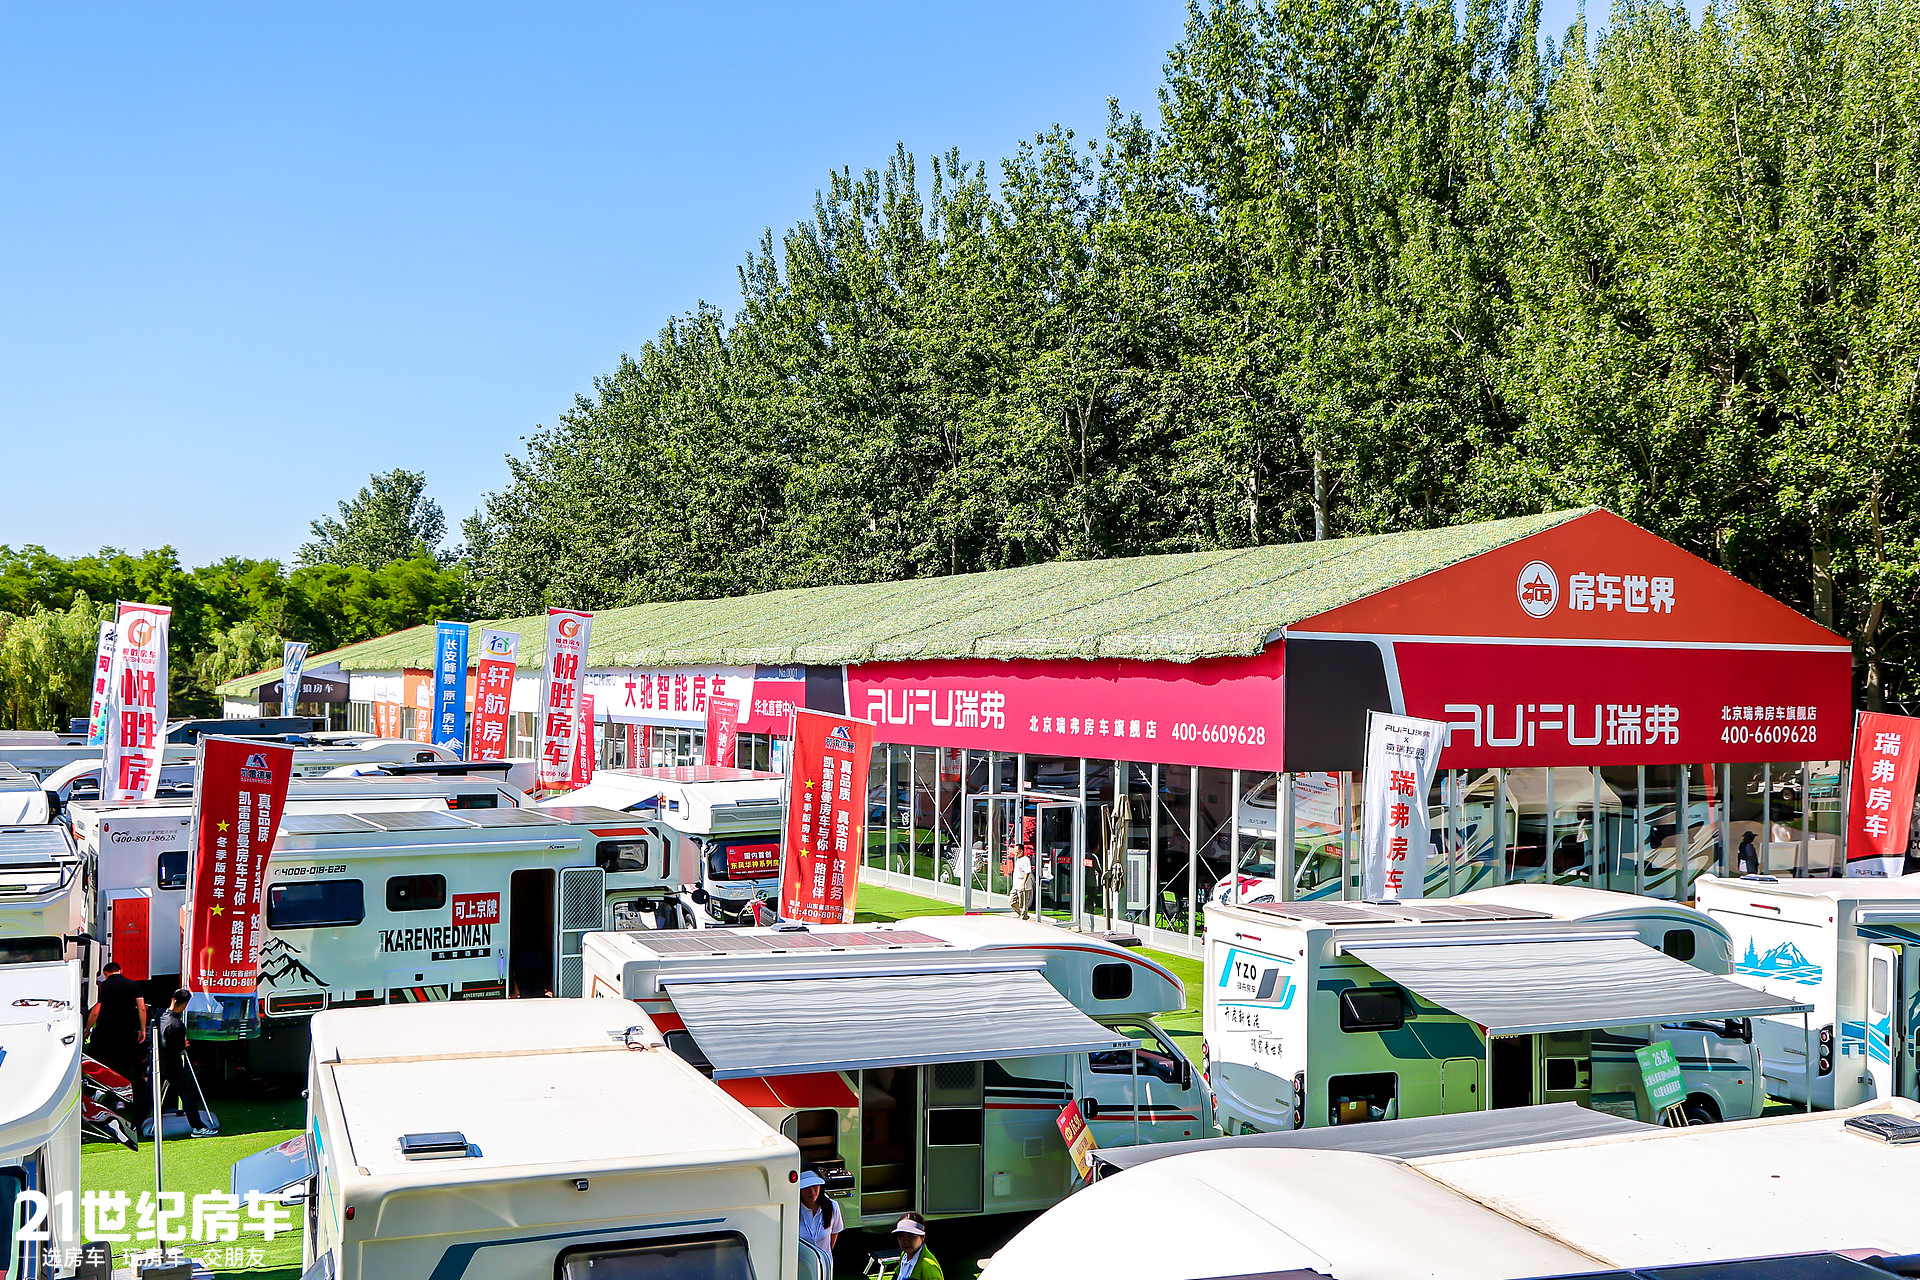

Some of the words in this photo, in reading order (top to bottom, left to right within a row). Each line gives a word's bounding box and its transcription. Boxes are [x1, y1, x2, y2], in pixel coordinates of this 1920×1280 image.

[1569, 572, 1676, 614] 房车世界
[441, 690, 456, 735] 原厂房车
[543, 652, 578, 766] 悦胜房车
[1029, 715, 1158, 739] 北京瑞弗房车旗舰店
[1721, 705, 1818, 721] 北京瑞弗房车旗舰店
[119, 668, 157, 799] 悦胜房
[1171, 722, 1266, 746] 400-6609628
[1721, 725, 1818, 744] 400-6609628
[839, 759, 853, 803] 真品质
[1863, 732, 1902, 838] 瑞弗房车
[115, 834, 177, 843] 400-801-8628
[257, 793, 272, 843] 真品质
[800, 792, 813, 844] 冬季版房车
[812, 756, 835, 899] 凯雷德曼房车与你一路相伴
[835, 810, 850, 852] 真实用
[1384, 770, 1416, 894] 瑞弗房车
[213, 836, 228, 899] 冬季版房车
[230, 790, 252, 964] 凯雷德曼房车与你一路相伴
[830, 858, 846, 901] 好服务
[454, 899, 498, 920] 可上京牌
[384, 923, 491, 953] KARENREDMAN
[1235, 961, 1257, 981] YZO
